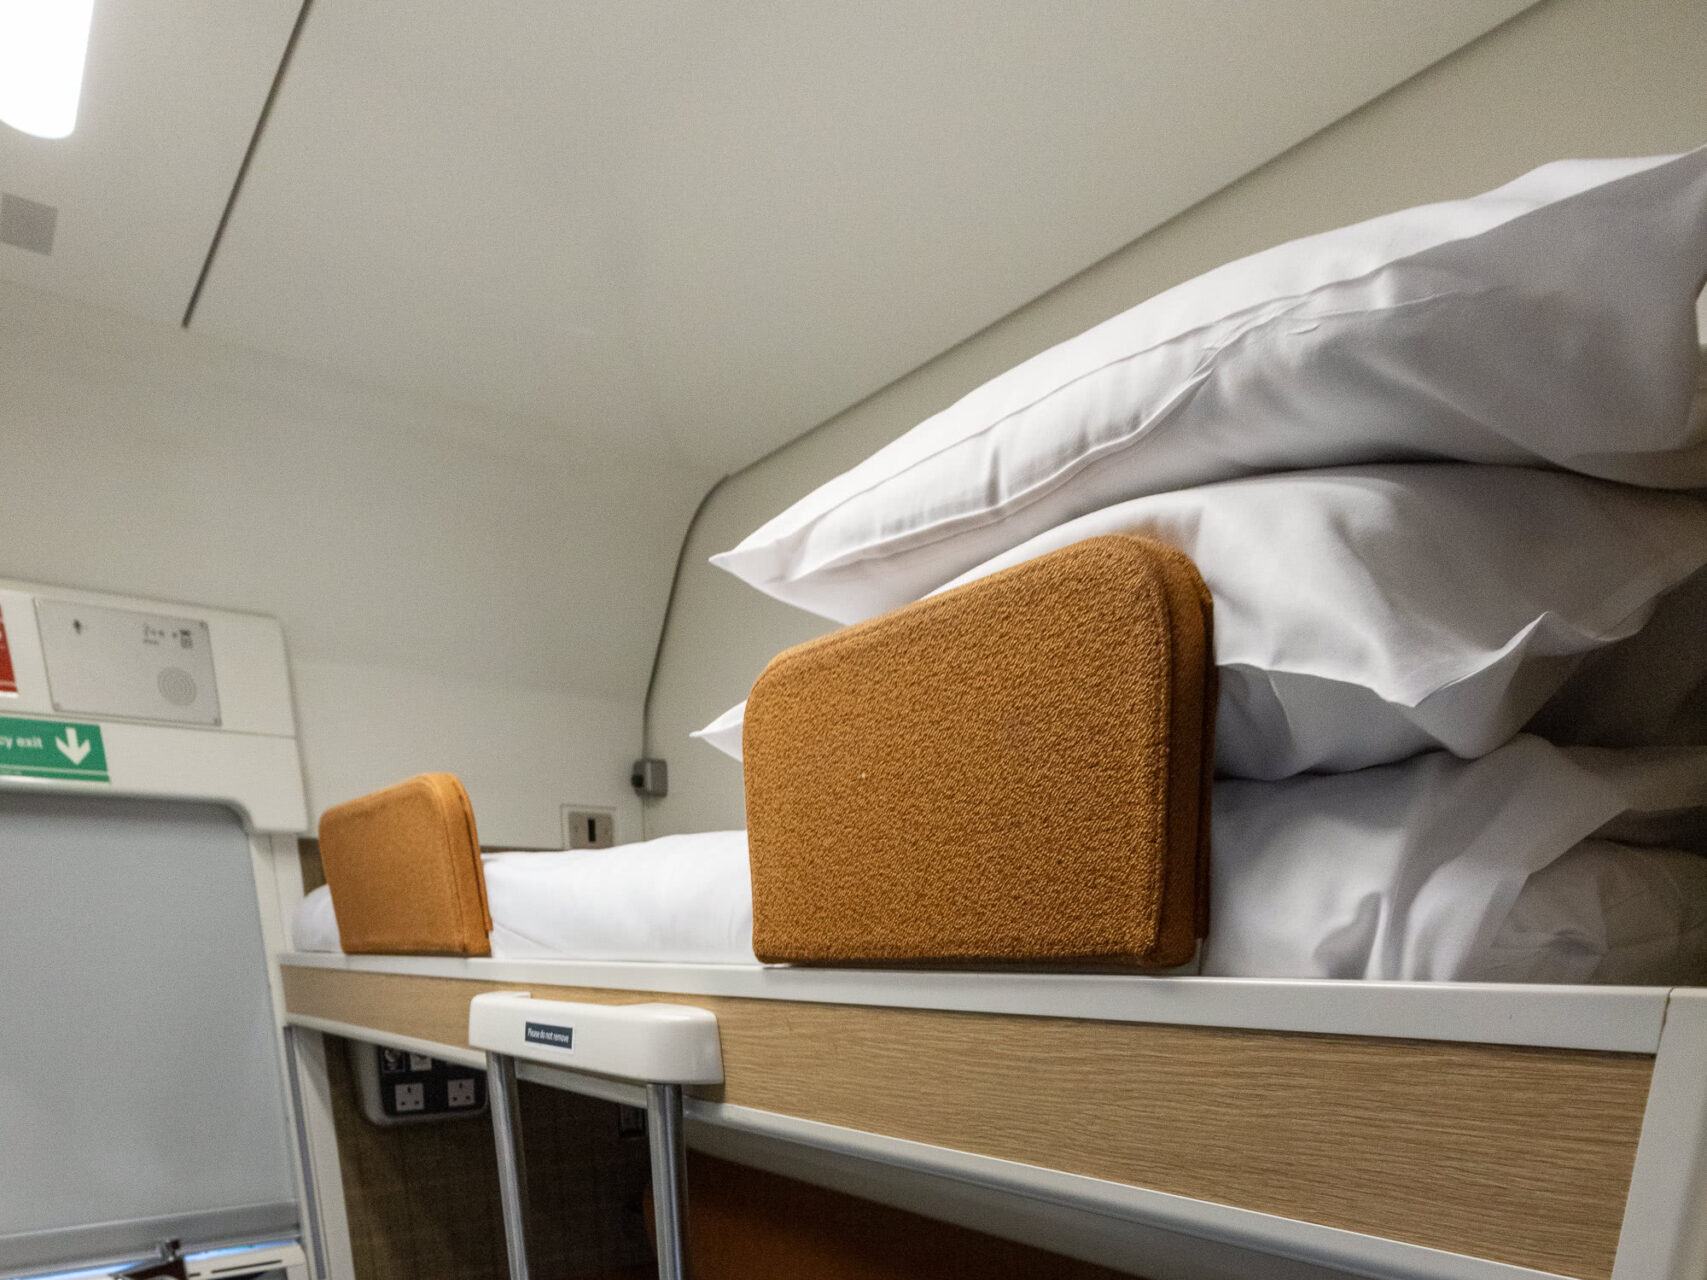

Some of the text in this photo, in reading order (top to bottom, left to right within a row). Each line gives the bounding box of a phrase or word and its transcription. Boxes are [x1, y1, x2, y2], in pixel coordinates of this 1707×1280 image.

[16, 736, 43, 750] exit
[527, 1027, 540, 1039] Please
[545, 1031, 553, 1040] not
[554, 1032, 569, 1043] remove
